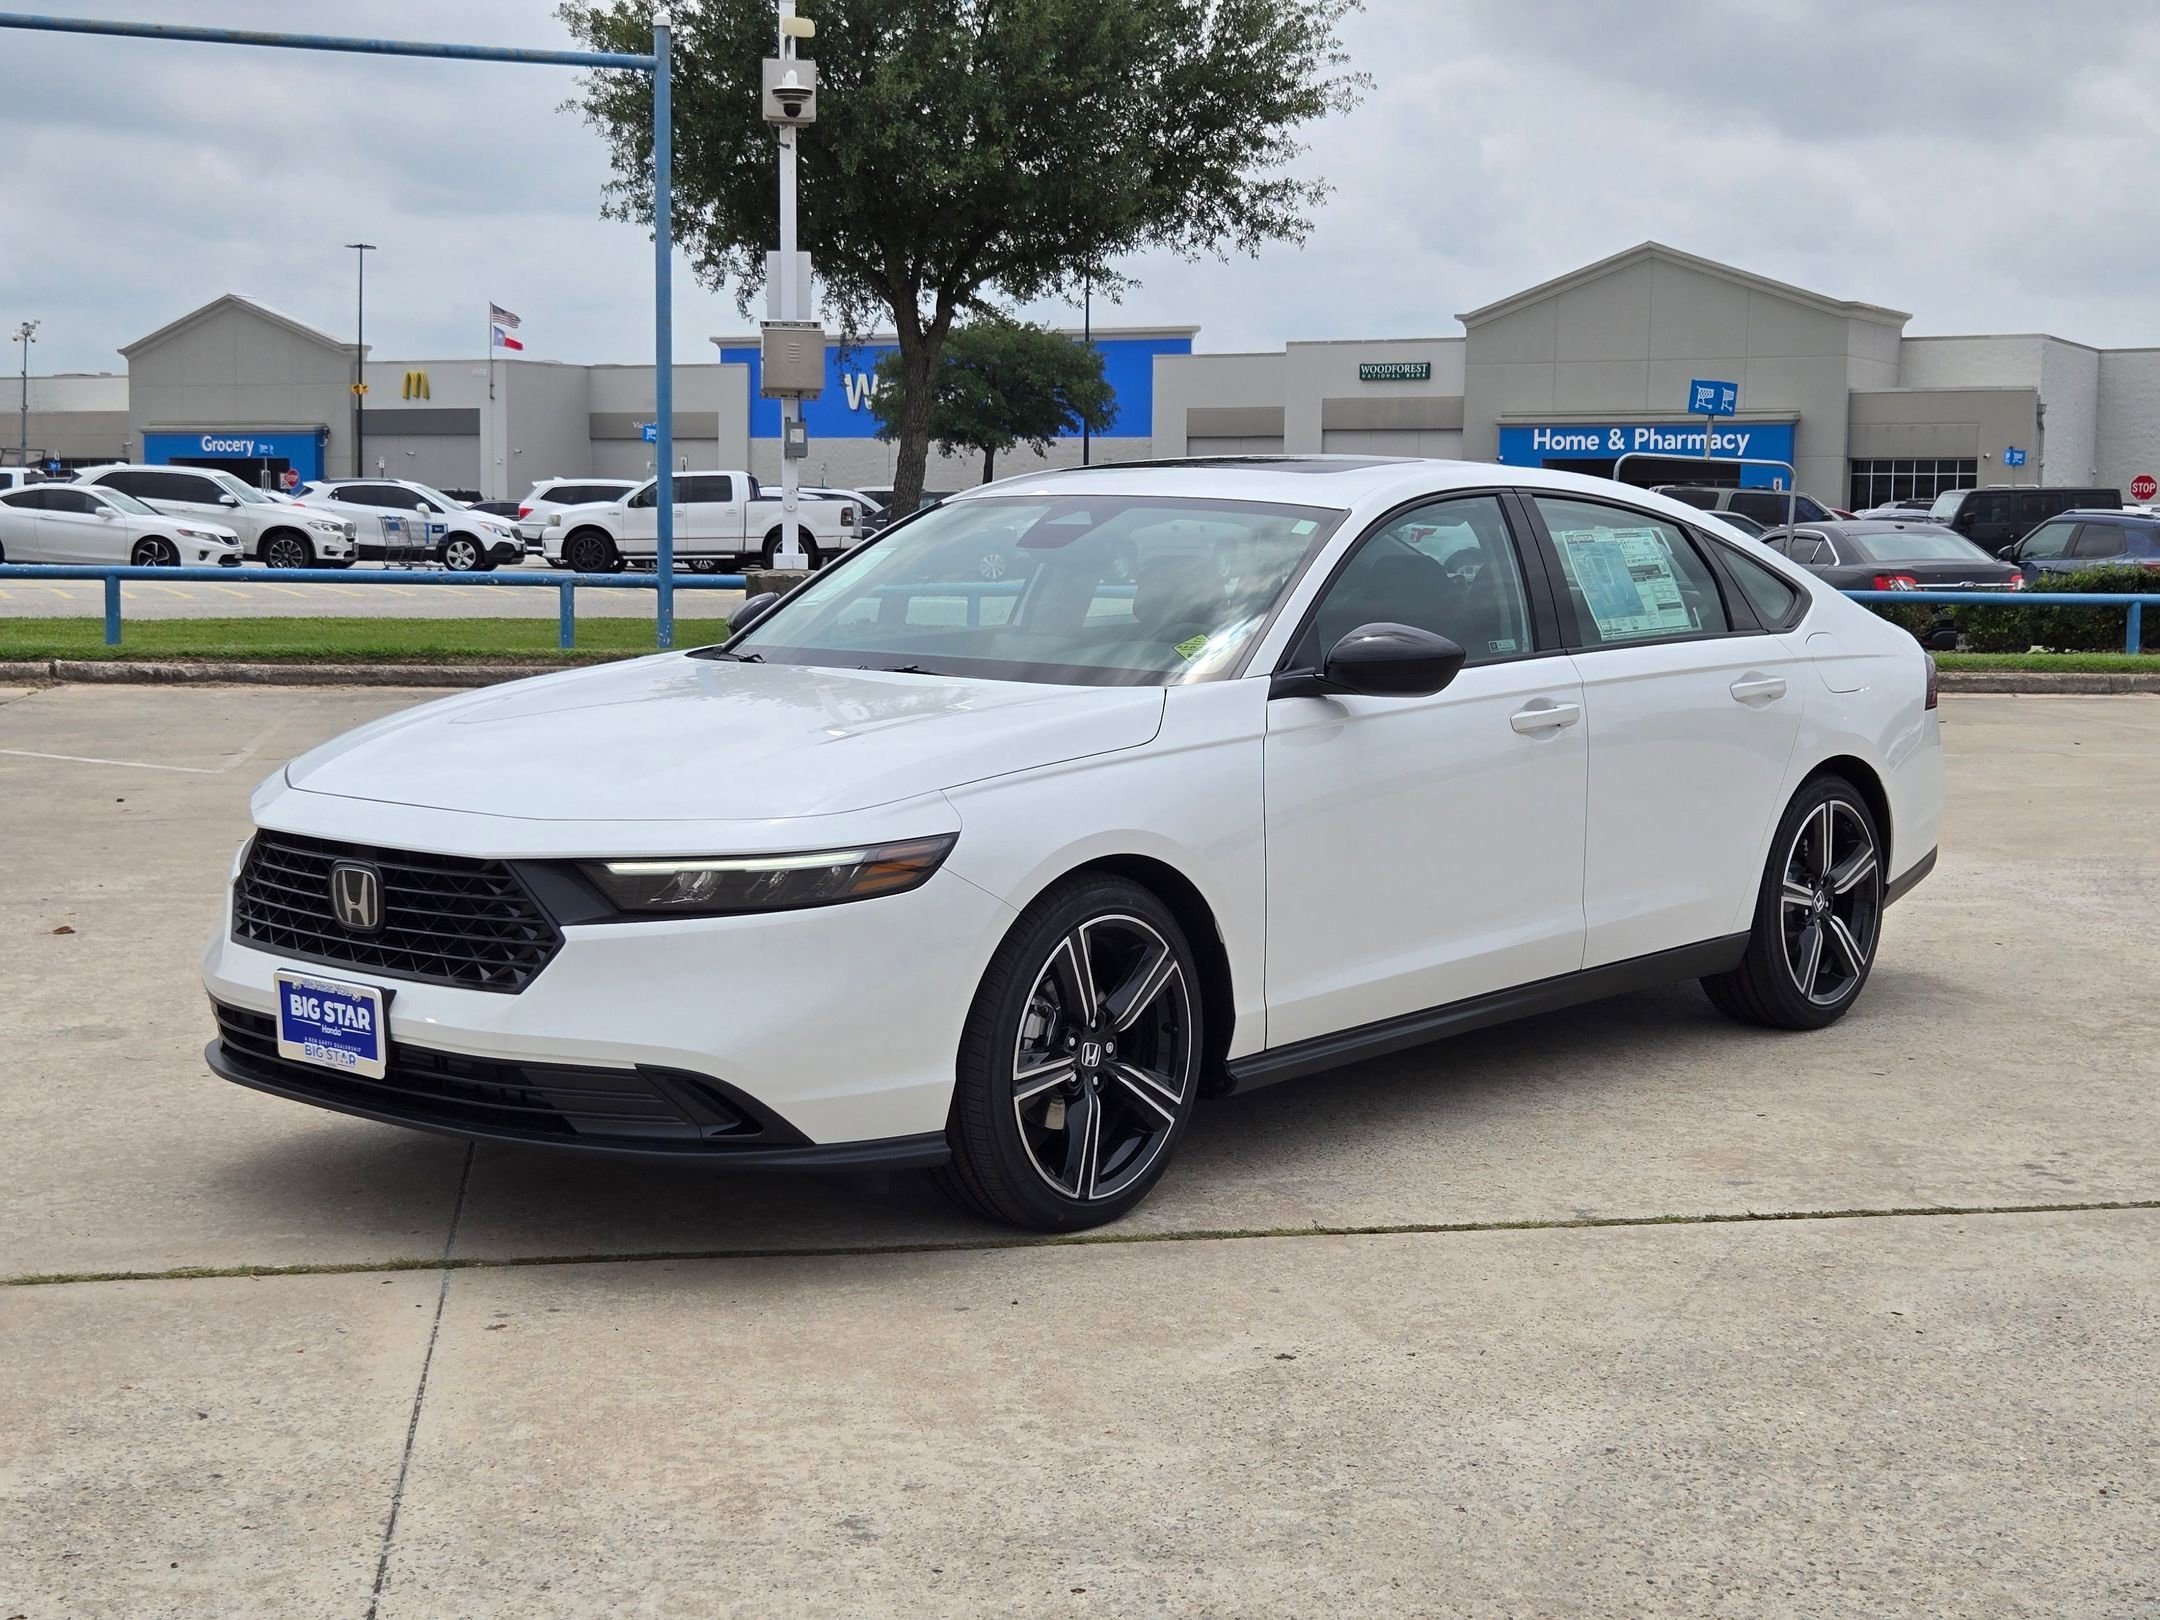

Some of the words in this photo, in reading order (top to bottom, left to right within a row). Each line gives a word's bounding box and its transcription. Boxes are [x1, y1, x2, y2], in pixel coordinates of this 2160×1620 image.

[1361, 364, 1427, 373] WOODFOREST
[201, 435, 255, 457] Grocery
[1533, 428, 1599, 450] Home
[1608, 428, 1625, 450] &
[1634, 428, 1750, 456] Pharmacy
[2131, 482, 2156, 493] STOP
[290, 994, 320, 1020] BIG
[323, 1001, 371, 1030] STAR
[321, 1024, 342, 1037] Honda
[305, 1044, 324, 1058] BIG
[326, 1049, 356, 1065] STAR
